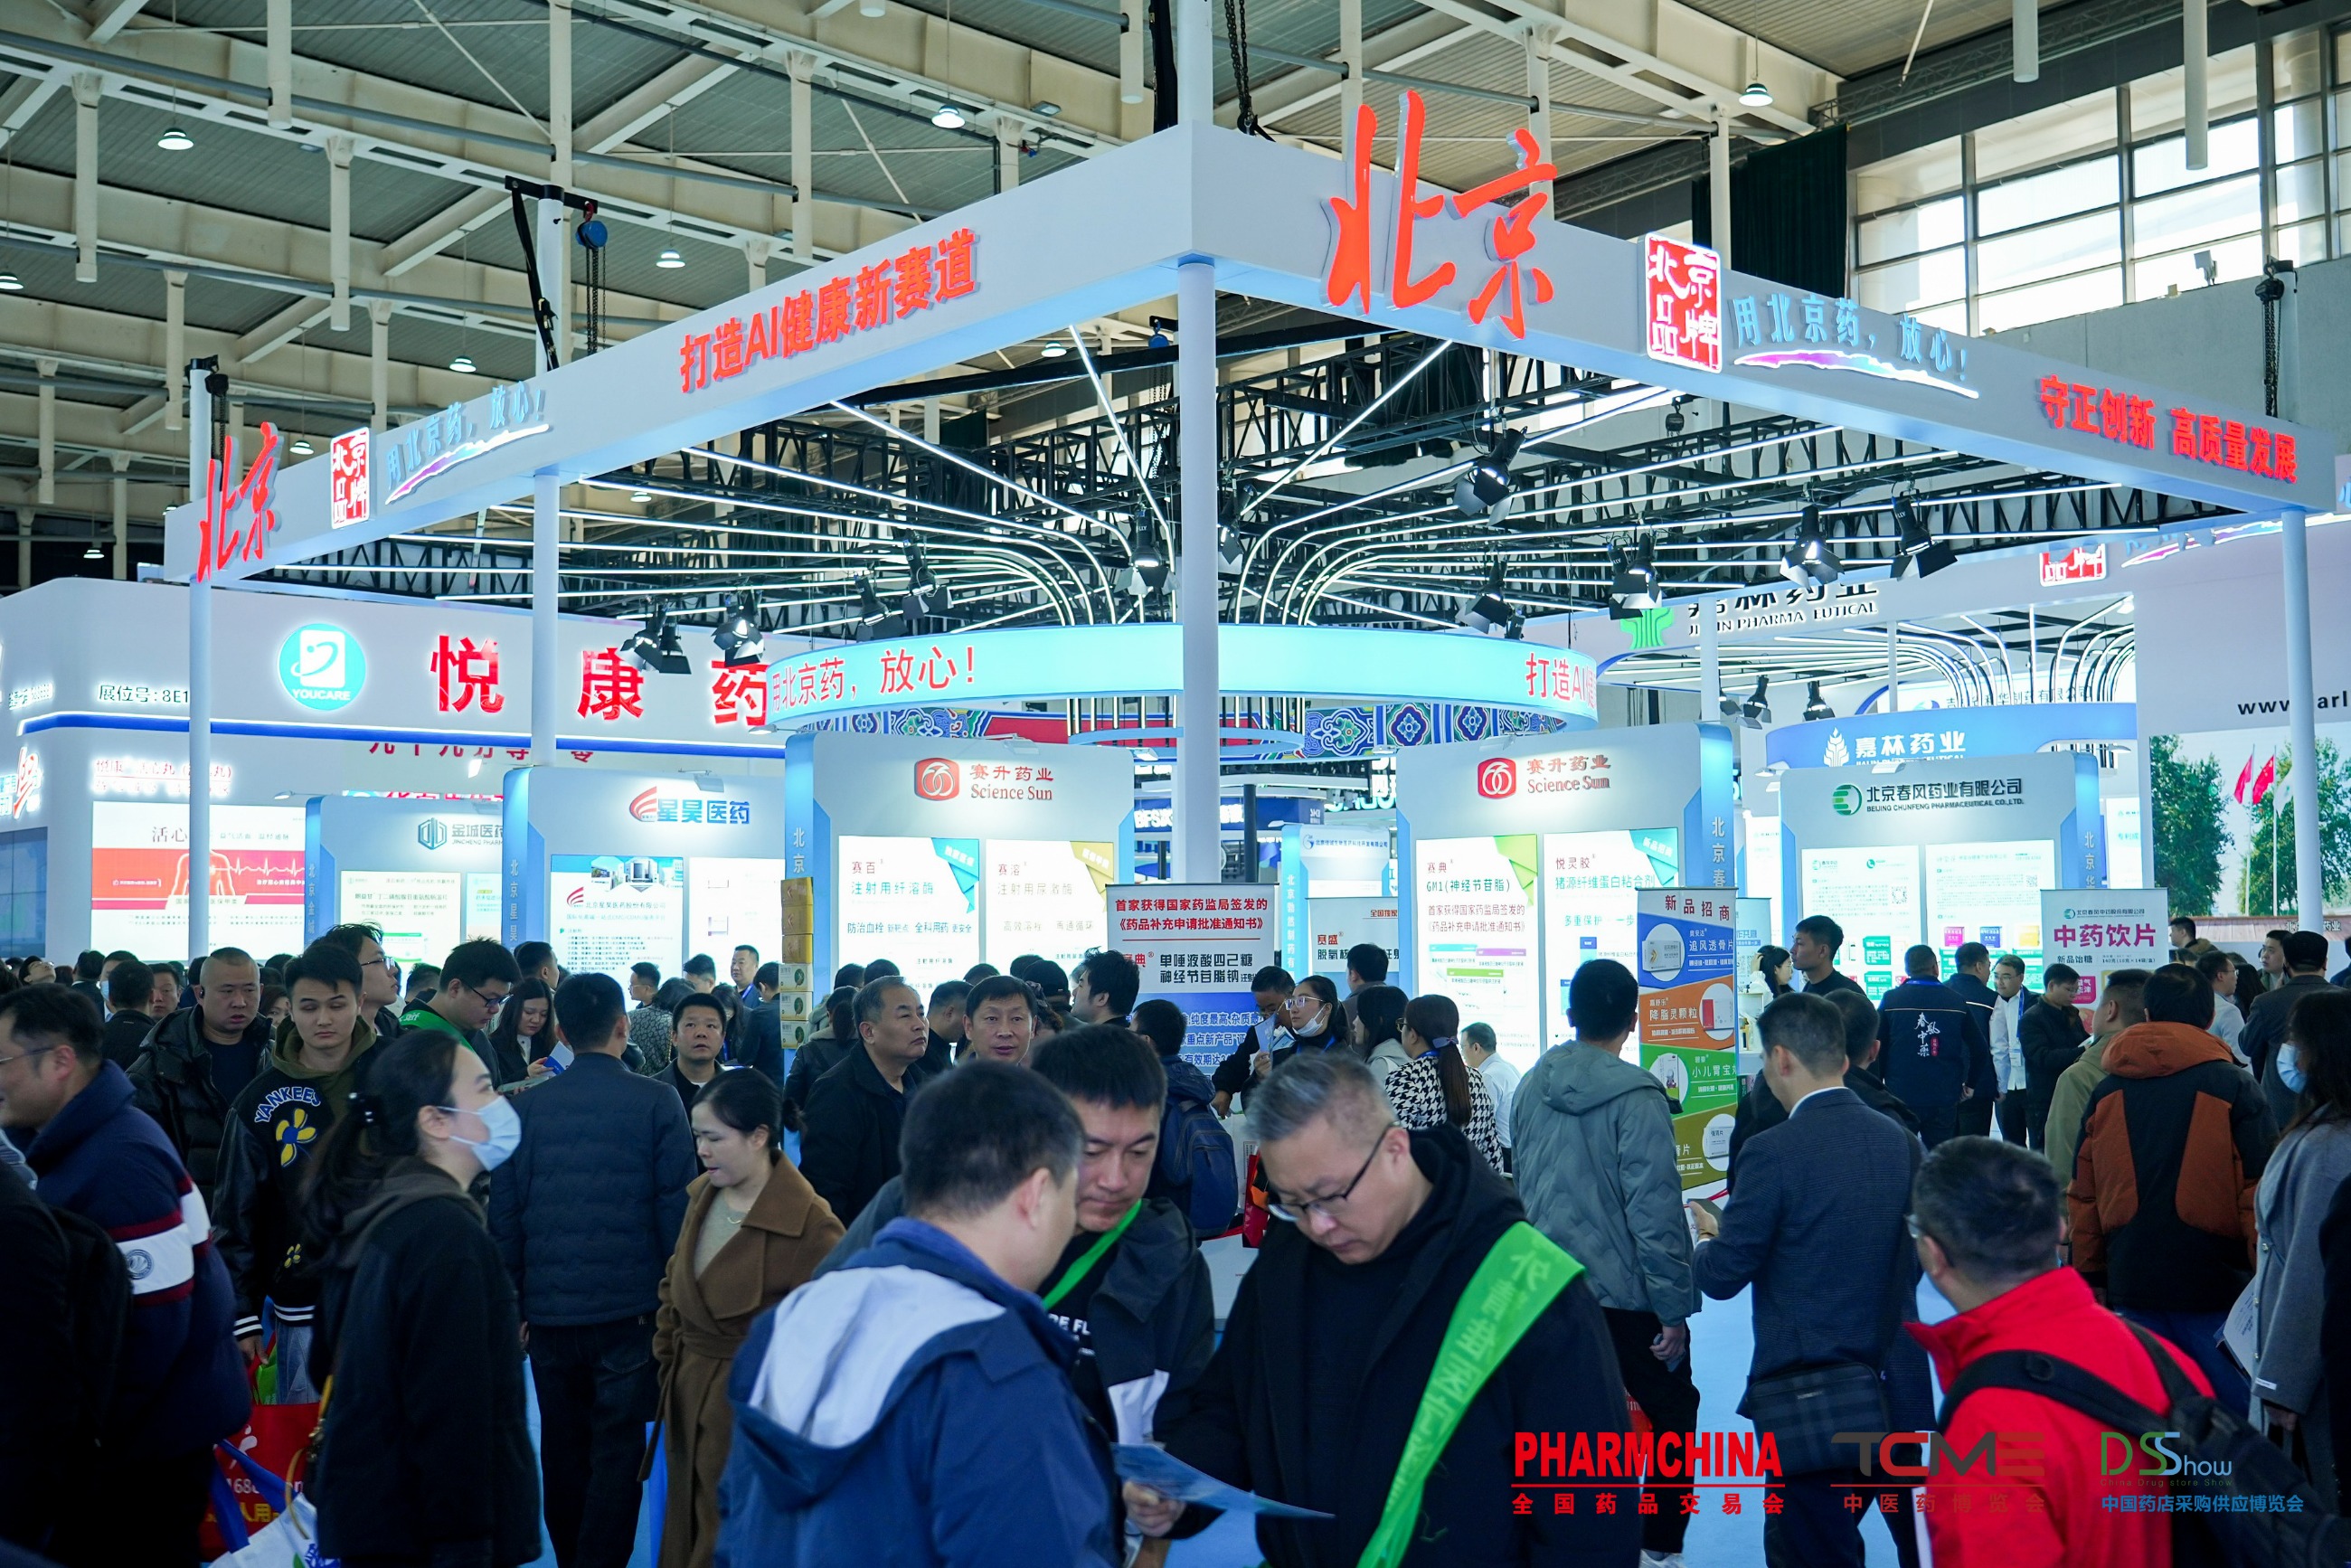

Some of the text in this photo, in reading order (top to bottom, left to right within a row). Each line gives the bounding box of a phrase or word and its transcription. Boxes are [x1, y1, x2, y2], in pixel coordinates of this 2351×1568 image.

[1326, 90, 1557, 340] 北京
[1648, 246, 1718, 302] 北京
[680, 227, 977, 394] 打造AI健康新赛道
[1651, 293, 1720, 369] 品牌
[2039, 373, 2299, 484] 守正创新 高质量发展
[332, 433, 368, 473] 北京
[197, 421, 279, 583] 北京
[333, 477, 368, 524] 品牌
[1689, 620, 1732, 636] JIIN
[1737, 610, 1804, 630] PHARMA
[292, 688, 351, 702] YOUCARE
[1855, 731, 1966, 758] 嘉林药业
[1526, 753, 1610, 774] 赛升药业
[969, 764, 1053, 781] 赛升药业
[970, 784, 1053, 800] Science Sun
[1527, 776, 1610, 793] Science Sun
[1866, 778, 2022, 802] 北京春风药业有限公司
[656, 798, 750, 825] 星昊医药
[1893, 803, 1930, 811] CHUNFENG
[1931, 800, 1993, 809] PHARMACEUTICAL
[152, 827, 188, 843] 活心
[793, 827, 806, 874] 北京
[1555, 856, 1590, 870] 悦灵胶
[852, 882, 934, 895] 注射用纤溶酶
[1555, 874, 1656, 890] 猪源纤维蛋白粘合剂
[510, 860, 519, 942] 北京星昊
[1115, 898, 1268, 912] 首家获得国家药监局签发的
[1665, 894, 1730, 921] 新品招商
[1428, 904, 1525, 916] 首家获得国家药监局签发的
[847, 922, 884, 933] 防治血栓
[915, 922, 949, 933] 全科用药
[952, 924, 972, 933] 更安全
[1119, 918, 1264, 930] 《药品补充申请批准通知书》
[1428, 921, 1525, 932] 《药品补充申请批准通知书》
[1564, 915, 1602, 927] 多重保护
[2054, 922, 2157, 948] 中药饮片
[1689, 940, 1734, 951] 追风透骨片
[1160, 953, 1253, 968] 单唾液酸四己糖
[1160, 970, 1255, 983] 神经节苷脂钠 注射
[1649, 1007, 1698, 1021] 降脂灵颗粒
